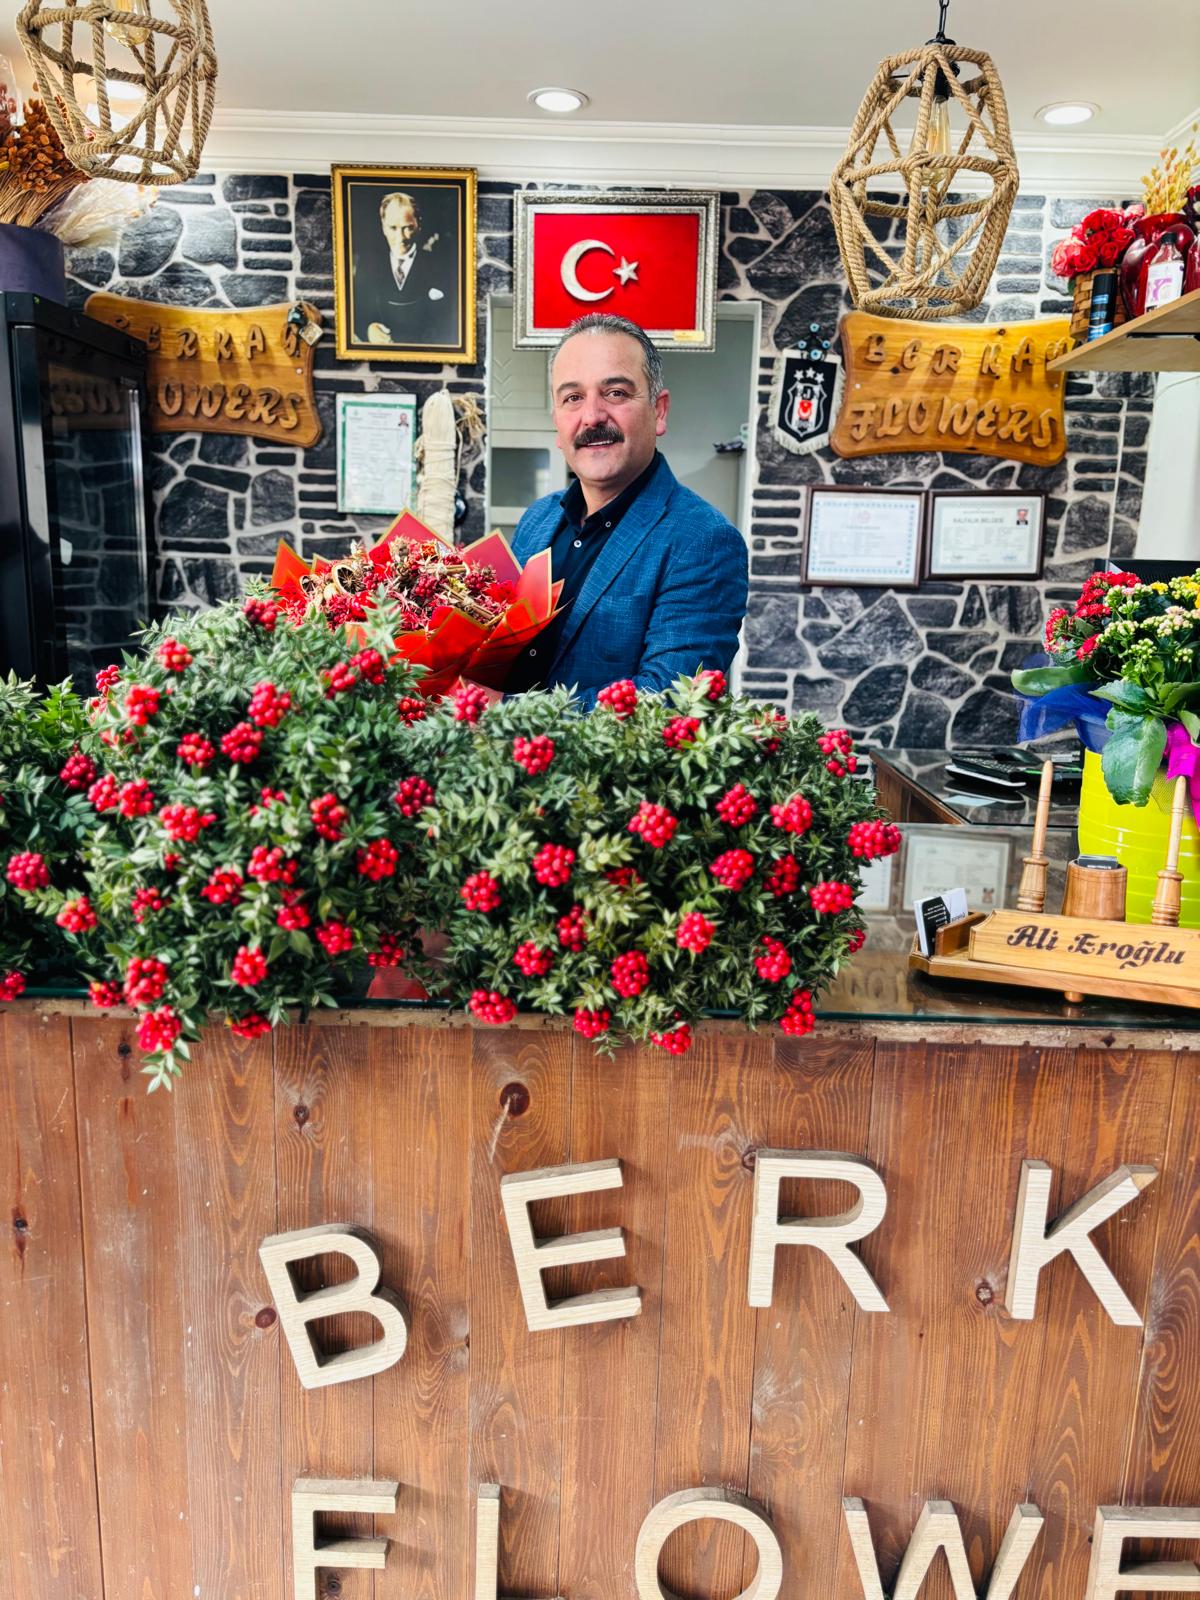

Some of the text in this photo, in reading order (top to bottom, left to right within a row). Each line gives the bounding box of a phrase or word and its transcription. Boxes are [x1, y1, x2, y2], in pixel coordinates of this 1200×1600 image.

[159, 378, 304, 429] OWERS
[851, 396, 1054, 448] FLOWERS
[1007, 925, 1186, 969] Ali Eroğlu
